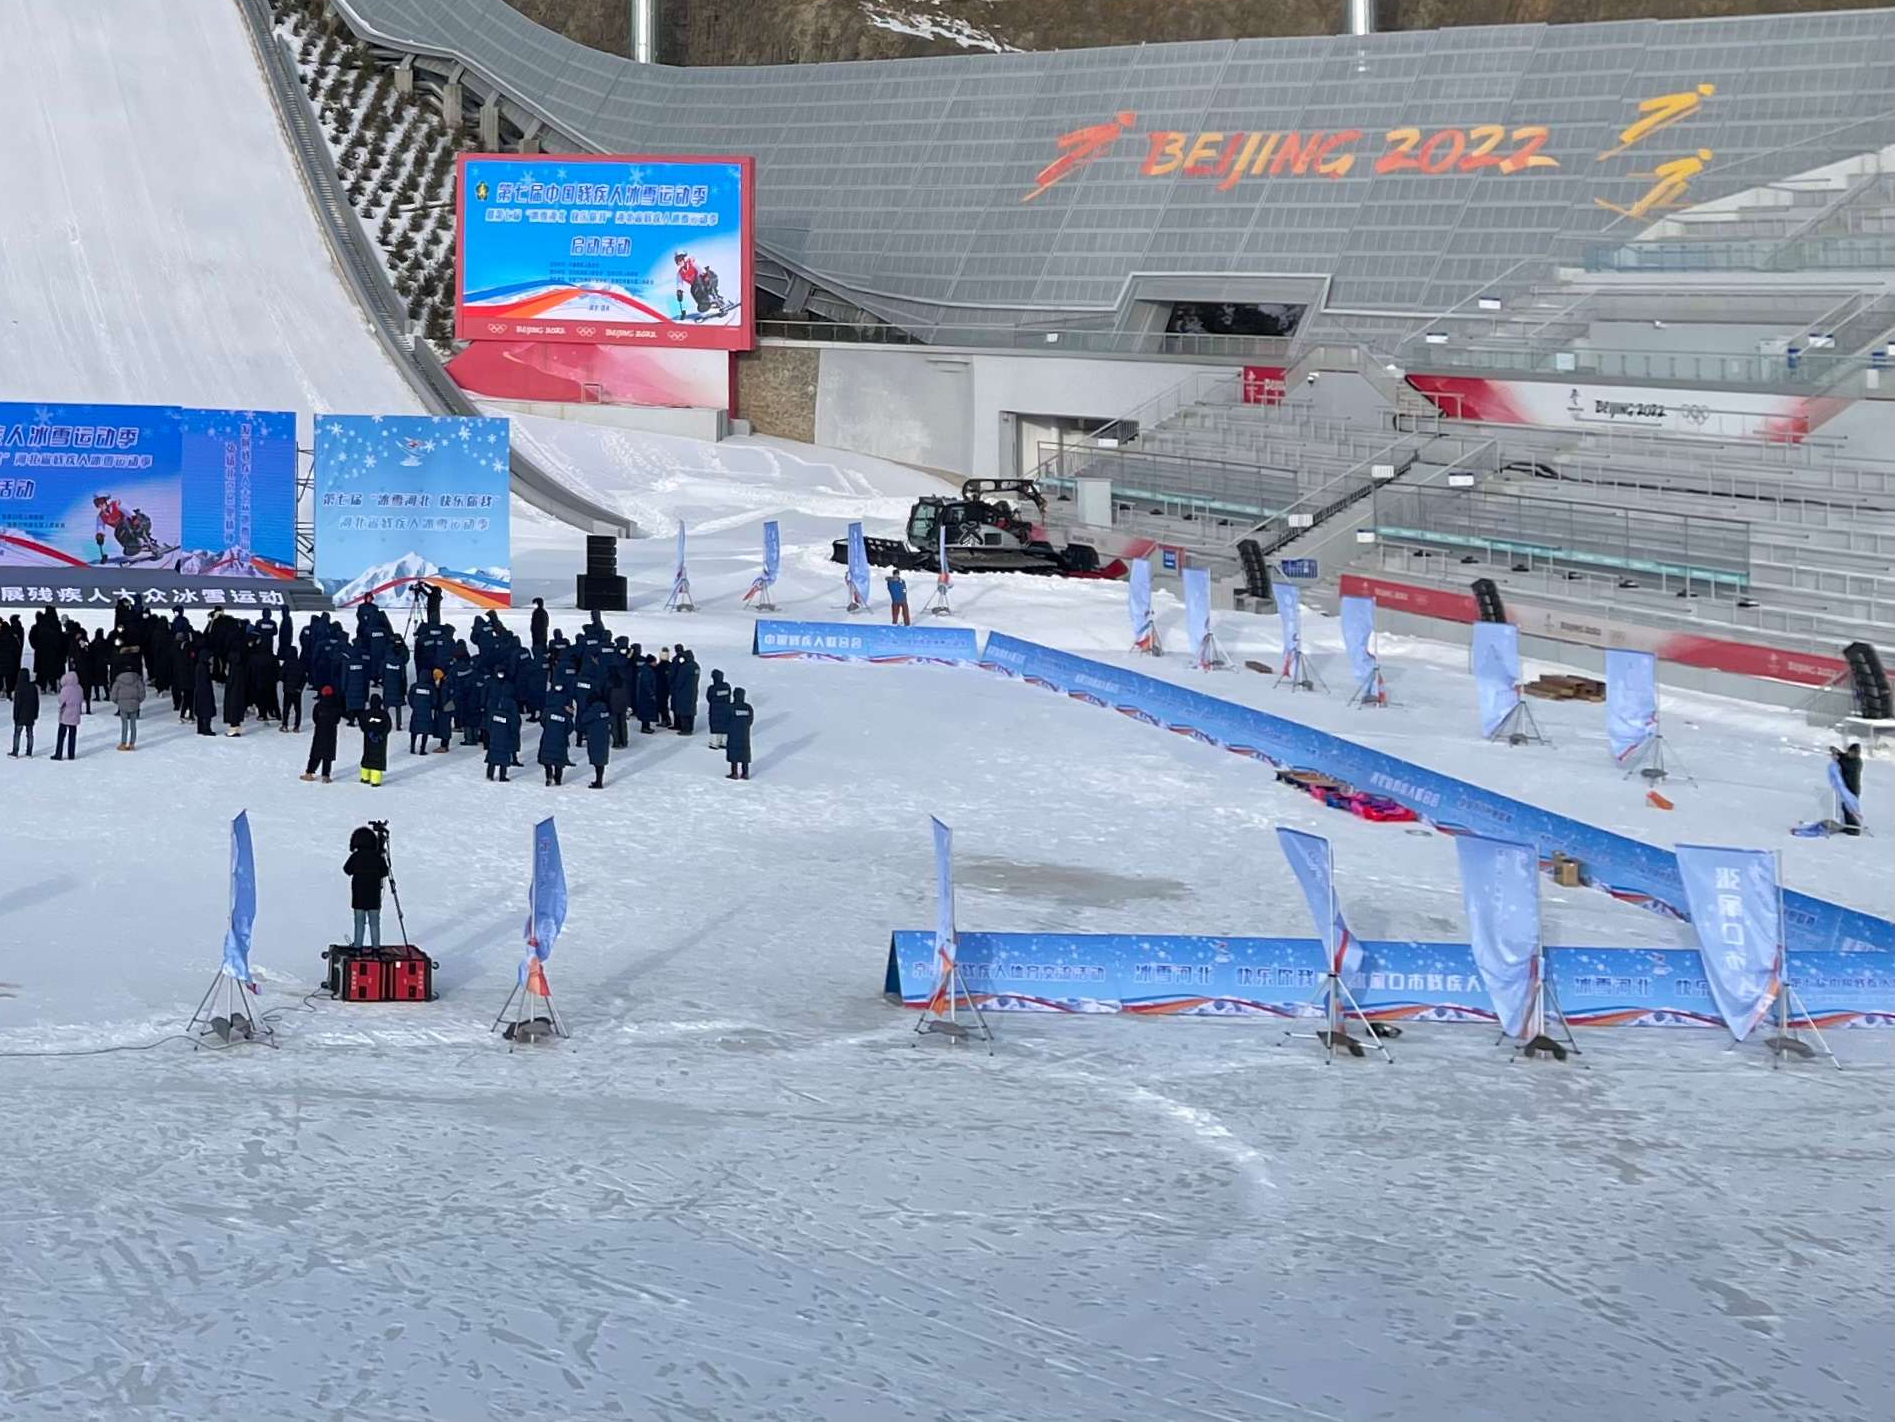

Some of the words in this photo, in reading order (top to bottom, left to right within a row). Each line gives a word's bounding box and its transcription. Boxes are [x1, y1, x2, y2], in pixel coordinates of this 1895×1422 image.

[1139, 129, 1364, 192] BEIJING
[1375, 124, 1562, 176] 2022
[497, 182, 708, 207] 第七届中国残疾人冰雪运动季
[570, 235, 632, 257] 启动活动
[1595, 399, 1634, 419] BEIJING
[1636, 403, 1668, 418] 2022
[1134, 963, 1213, 986] 冰雪河北
[1237, 966, 1316, 988] 快乐你我
[1574, 975, 1651, 996] 冰雪河北
[1675, 979, 1711, 997] 快乐
